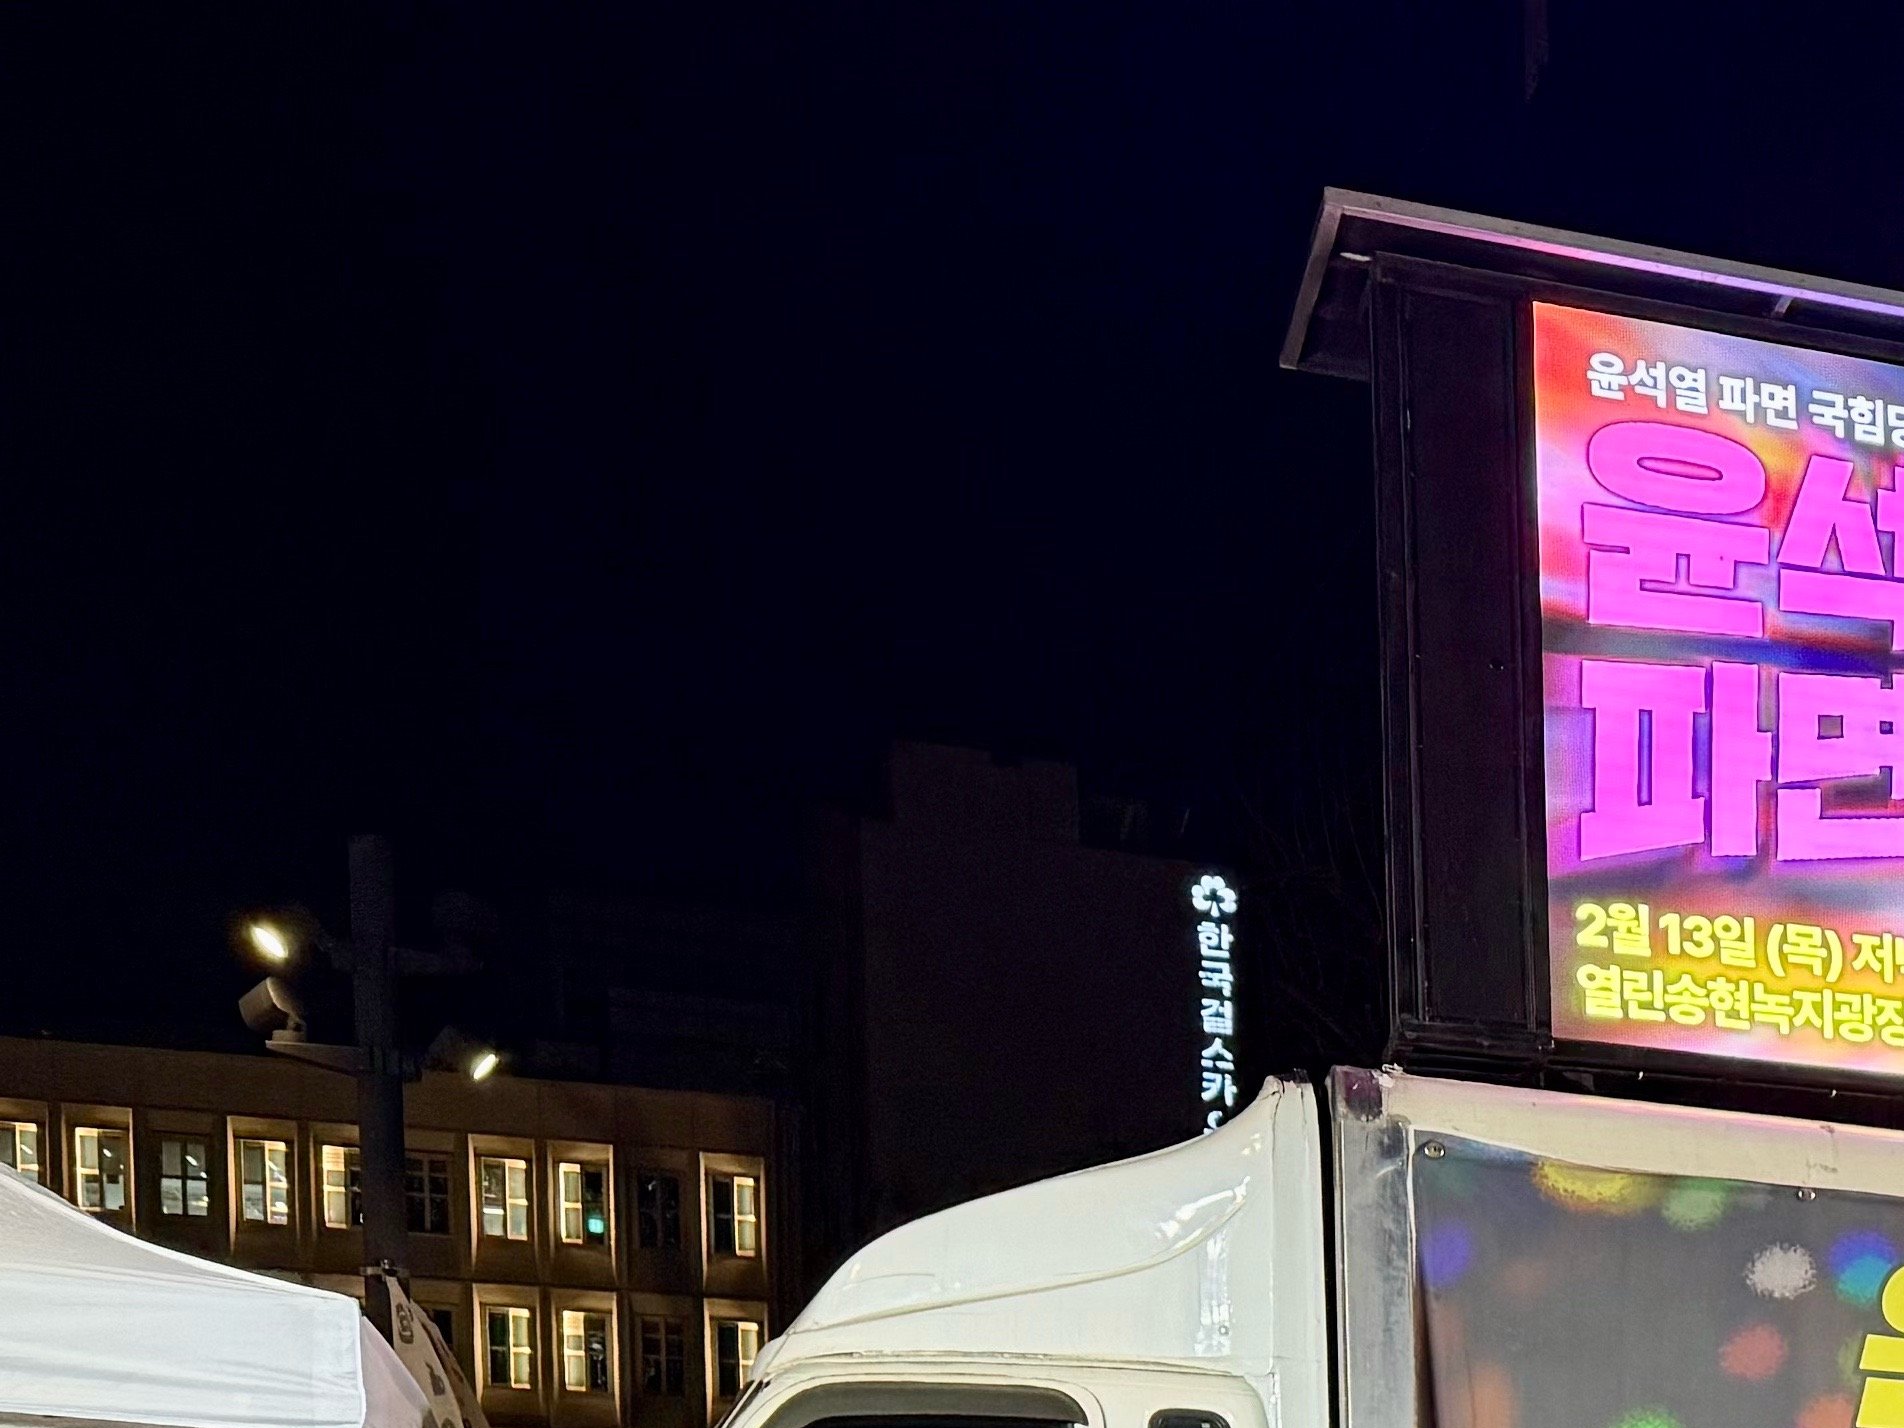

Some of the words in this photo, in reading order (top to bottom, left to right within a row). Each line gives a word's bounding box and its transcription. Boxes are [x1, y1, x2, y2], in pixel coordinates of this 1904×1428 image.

[1585, 351, 1708, 415] 윤석열
[1718, 376, 1799, 430] 파면
[1574, 902, 1651, 957] 2월
[1658, 911, 1757, 971] 13일
[1766, 919, 1844, 984] (목)
[1197, 921, 1238, 1136] 한국걸스카
